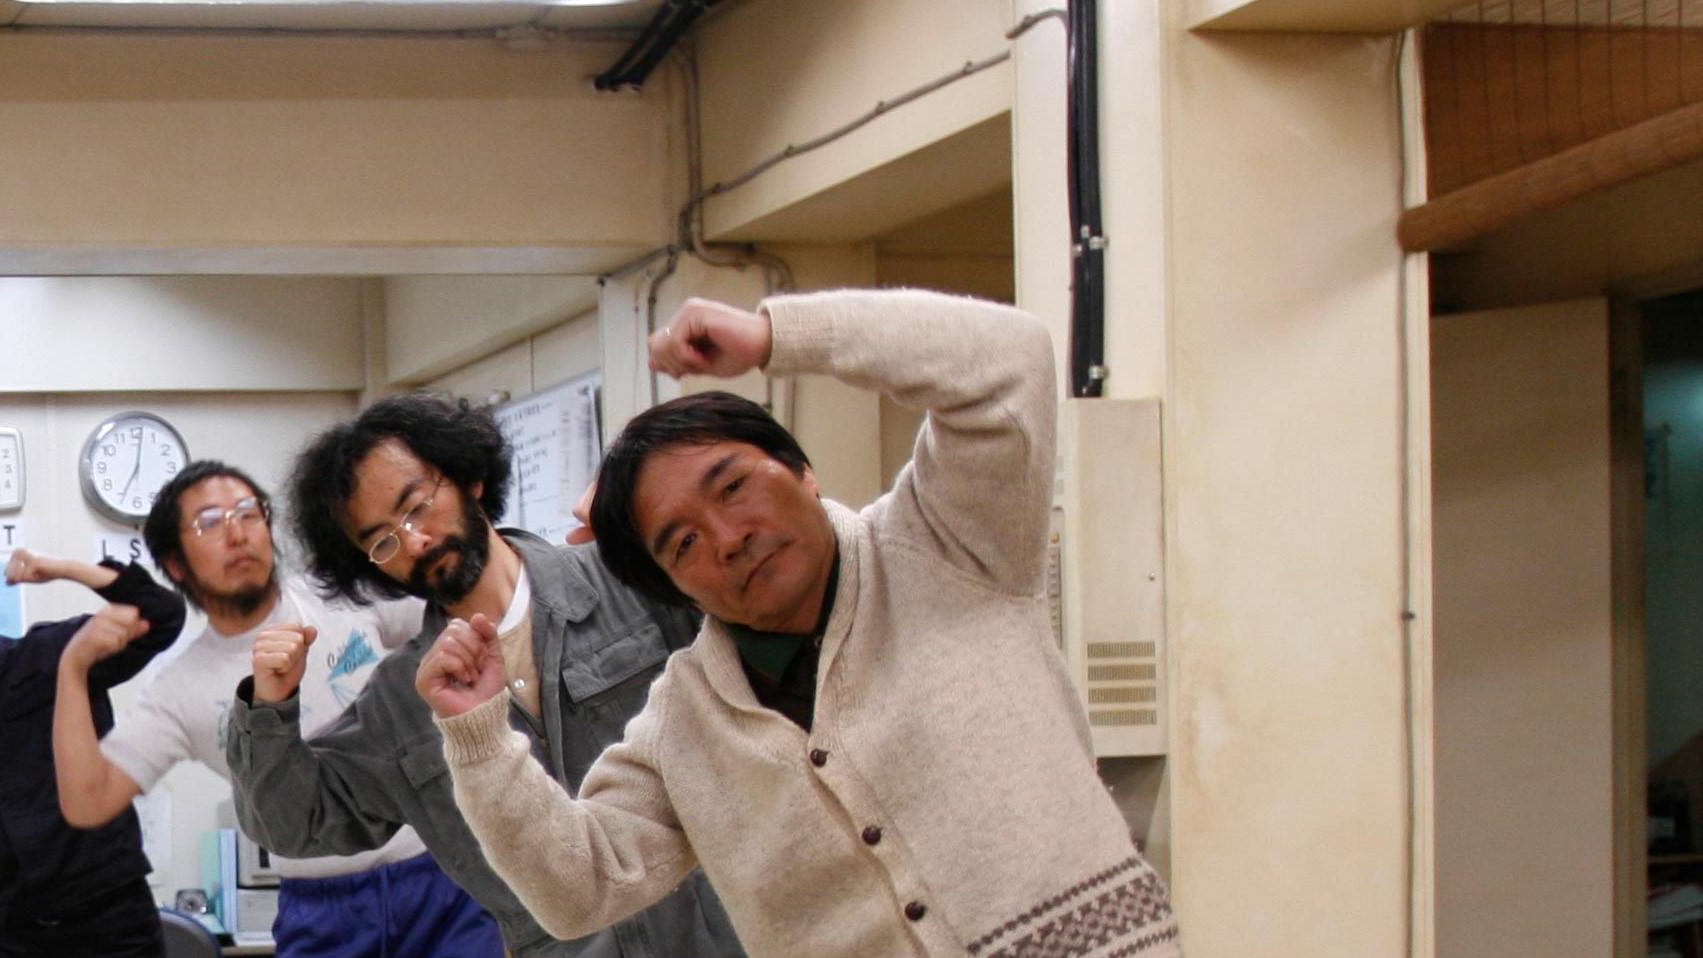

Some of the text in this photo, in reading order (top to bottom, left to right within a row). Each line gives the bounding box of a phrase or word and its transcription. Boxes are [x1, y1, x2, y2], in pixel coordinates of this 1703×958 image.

[116, 433, 125, 444] 11
[102, 444, 116, 457] 10
[160, 444, 171, 456] 2
[96, 461, 107, 474] 9
[167, 462, 176, 474] 3
[103, 479, 113, 491] 8
[132, 496, 143, 508] 6
